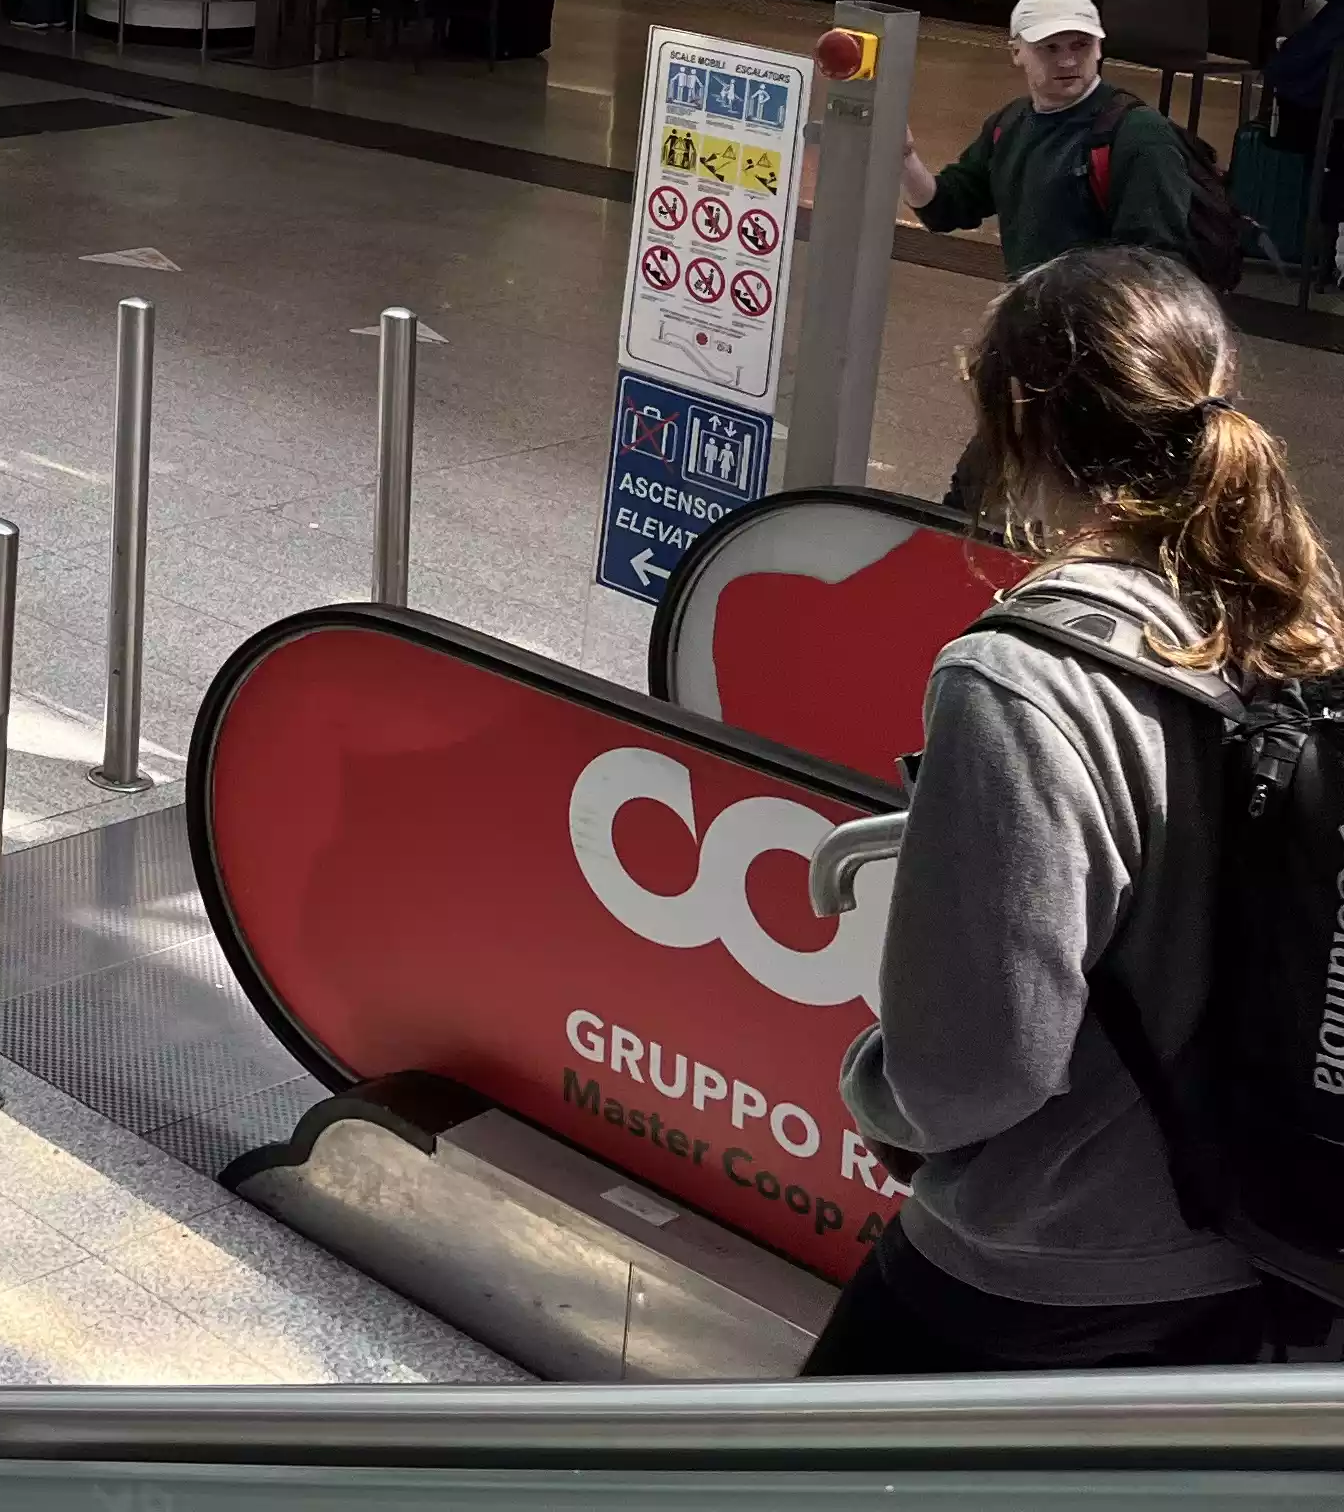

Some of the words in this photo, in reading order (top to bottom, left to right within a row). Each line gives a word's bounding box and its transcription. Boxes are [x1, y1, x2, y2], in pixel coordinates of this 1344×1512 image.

[670, 50, 696, 63] SCALE
[697, 57, 726, 70] MOBILI
[735, 64, 791, 84] ESCALATORS
[562, 1067, 709, 1166] Master
[722, 1146, 844, 1236] Coop
[564, 1008, 820, 1158] GRUPPO
